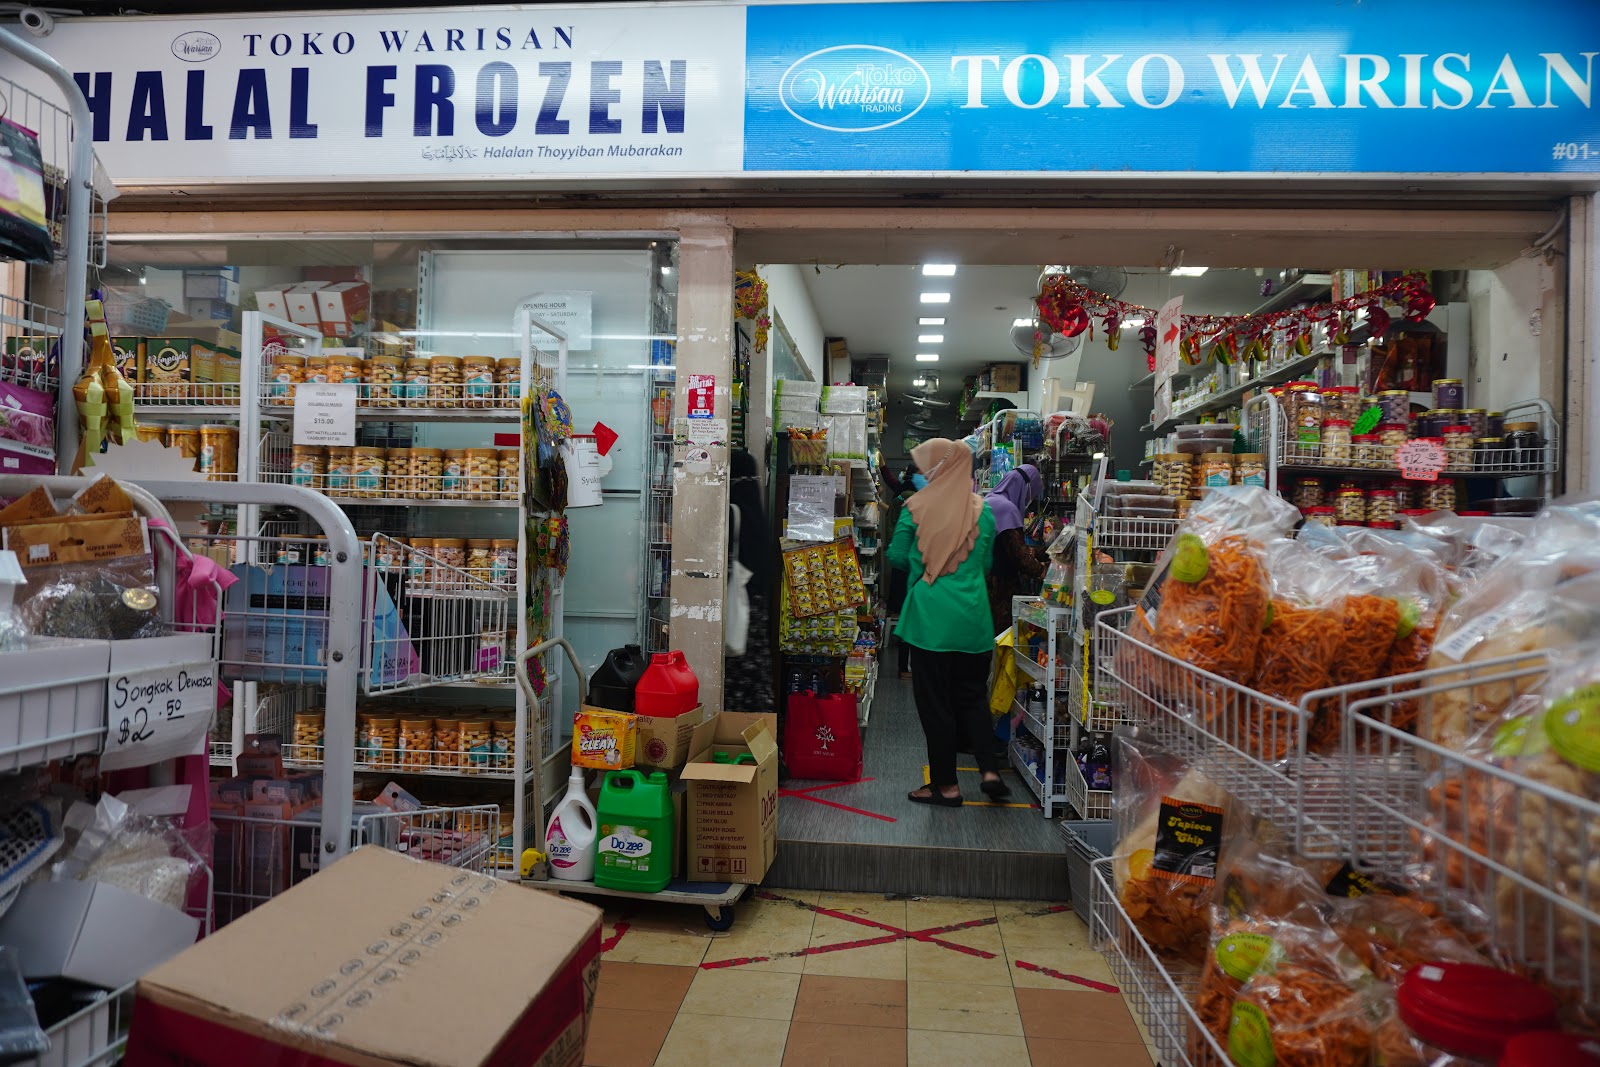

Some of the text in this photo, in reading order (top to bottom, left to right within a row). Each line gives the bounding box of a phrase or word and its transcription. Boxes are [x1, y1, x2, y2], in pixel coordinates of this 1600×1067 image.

[243, 26, 574, 57] TOKO WARISAN
[856, 64, 917, 86] Toko
[950, 52, 1599, 109] TOKO WARISAN
[791, 68, 905, 110] Warisan
[71, 60, 686, 142] HALAL FROZEN
[860, 104, 902, 113] TRADING
[483, 144, 683, 161] Halalan Thoyyiban Mubarakan
[313, 417, 334, 425] $15.00
[114, 676, 173, 709] Songkok
[636, 715, 654, 726] ality
[580, 738, 617, 751] CLEAN
[1167, 816, 1213, 832] Tapioca
[1174, 830, 1204, 847] Chip
